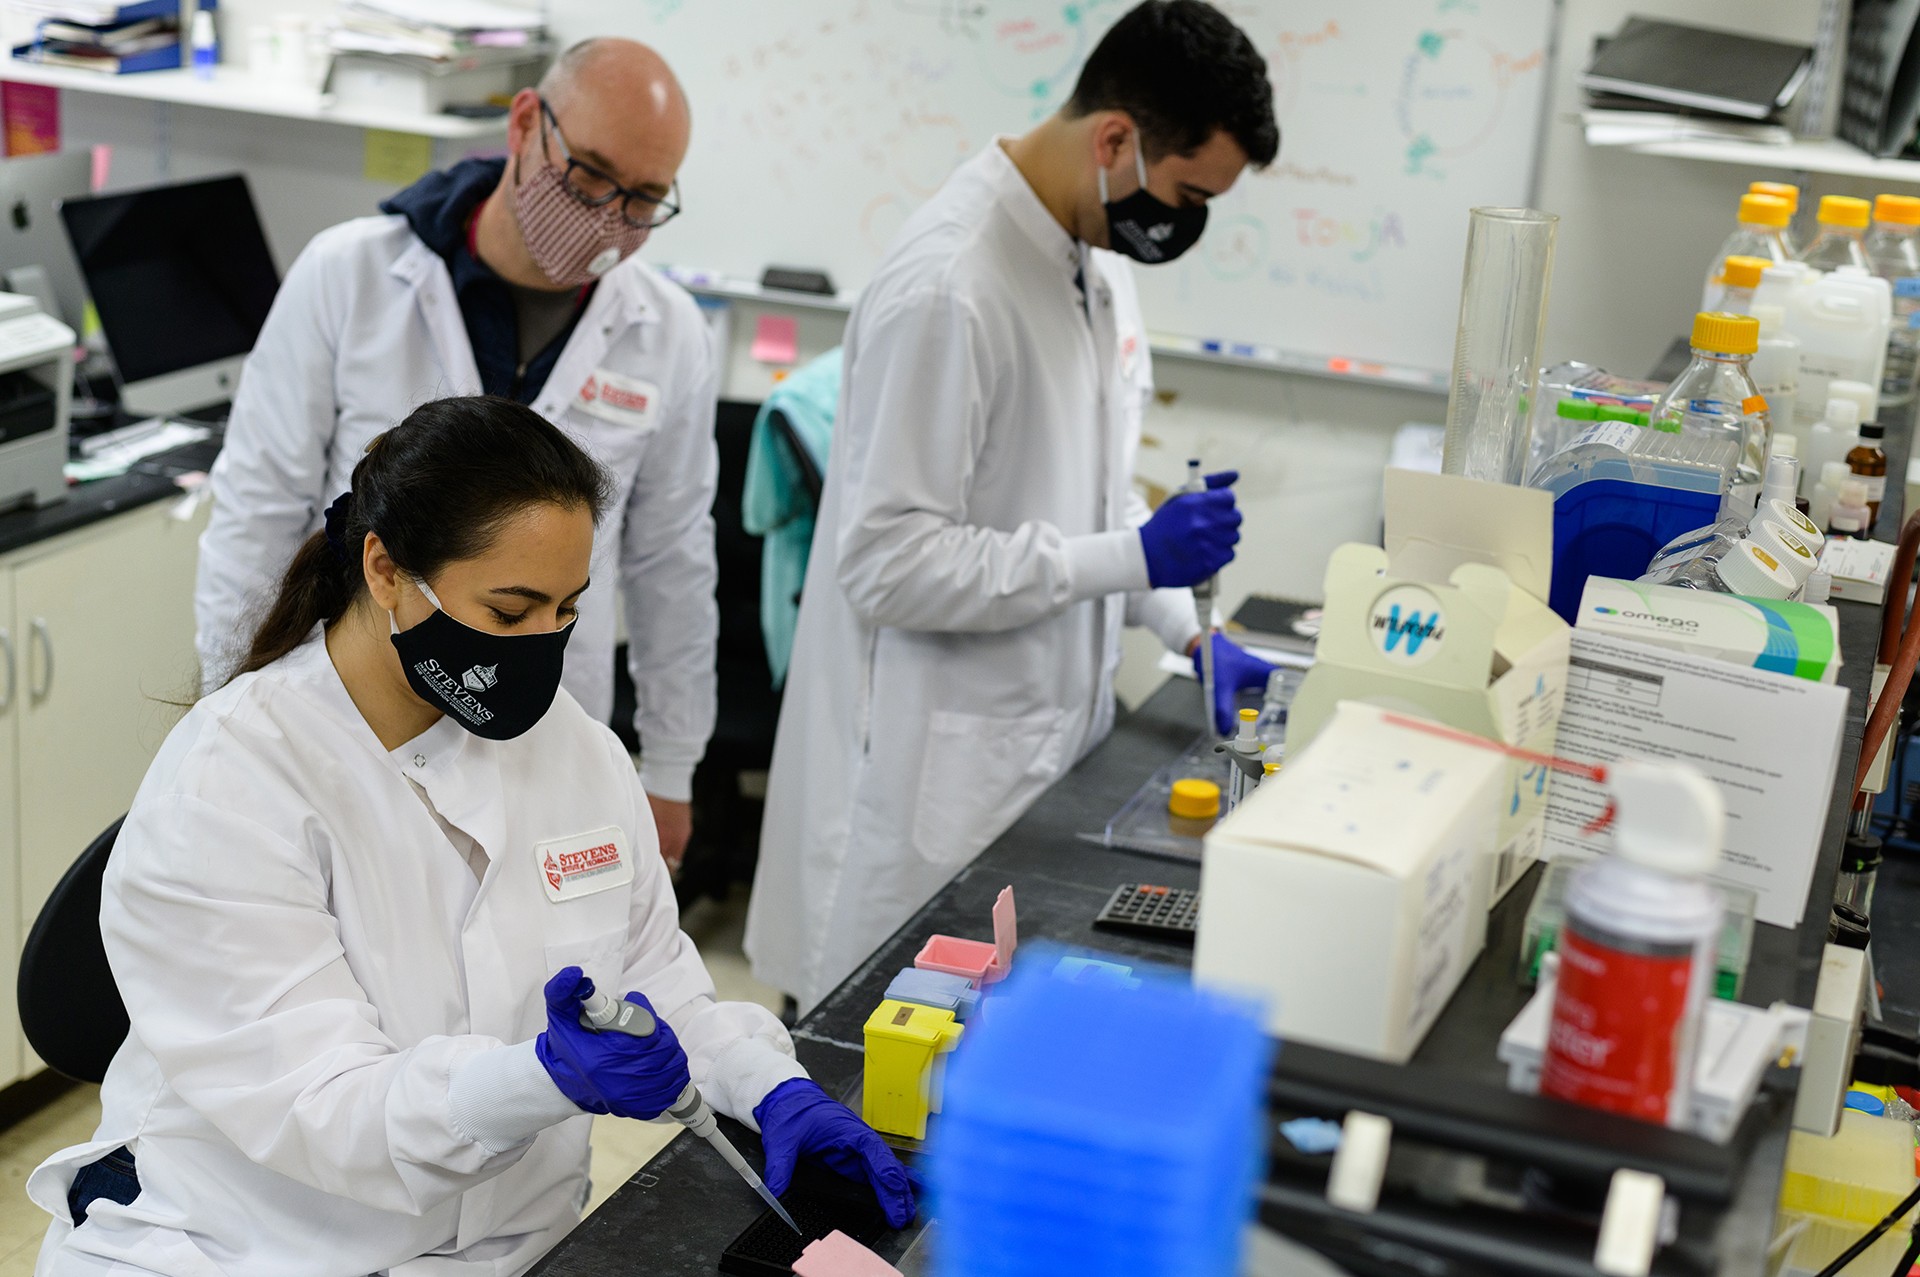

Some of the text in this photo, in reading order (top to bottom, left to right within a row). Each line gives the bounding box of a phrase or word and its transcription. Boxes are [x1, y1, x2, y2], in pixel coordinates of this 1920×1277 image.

[1621, 610, 1699, 628] omega
[424, 659, 494, 720] STEVENS
[450, 694, 486, 724] TECHNOLOGY
[559, 843, 617, 866] STEVENS
